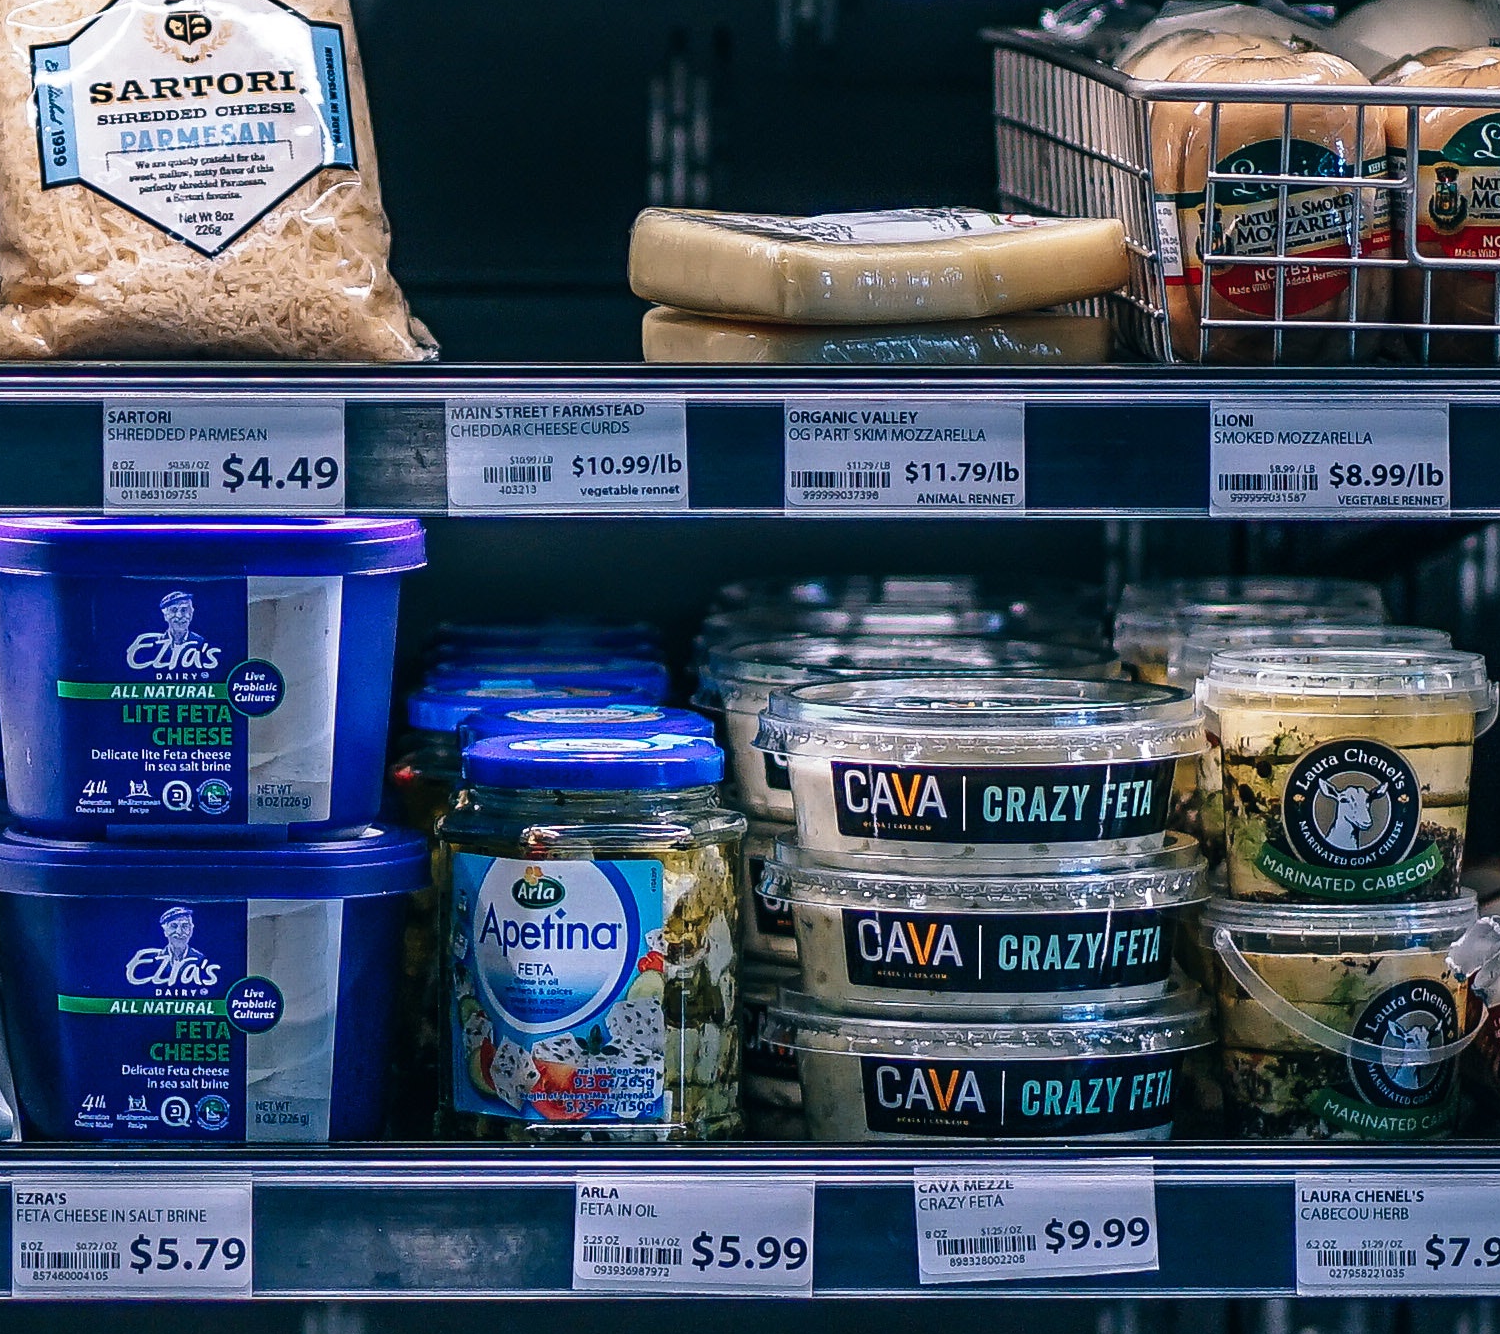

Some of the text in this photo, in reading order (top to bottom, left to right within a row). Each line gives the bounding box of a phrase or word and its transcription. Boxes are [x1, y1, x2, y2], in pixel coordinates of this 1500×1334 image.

[89, 70, 296, 105] SARTORI
[97, 101, 296, 126] SHREDDED CHEESE
[120, 120, 276, 152] PARMESAN
[1214, 414, 1254, 428] LIONI
[107, 426, 268, 442] SHREDDED PARMESAN
[1214, 430, 1373, 445] SMOKED MOZZARELLA
[222, 452, 339, 494] $4.49
[905, 460, 1020, 485] $11.79/lb
[1329, 461, 1444, 490] $8.99/lb
[110, 685, 216, 699] ALL NATURAL
[122, 704, 233, 724] LITE FETA
[152, 726, 233, 746] CHEESE
[844, 768, 948, 819] CAVA
[982, 779, 1152, 823] CRAZY FETA
[1263, 855, 1437, 893] MARINATED CABECOU
[478, 907, 617, 957] Apetina
[16, 1192, 67, 1206] EZRA'S
[1301, 1189, 1425, 1204] LAURA CHENEL'S
[129, 1233, 246, 1275] $5.79
